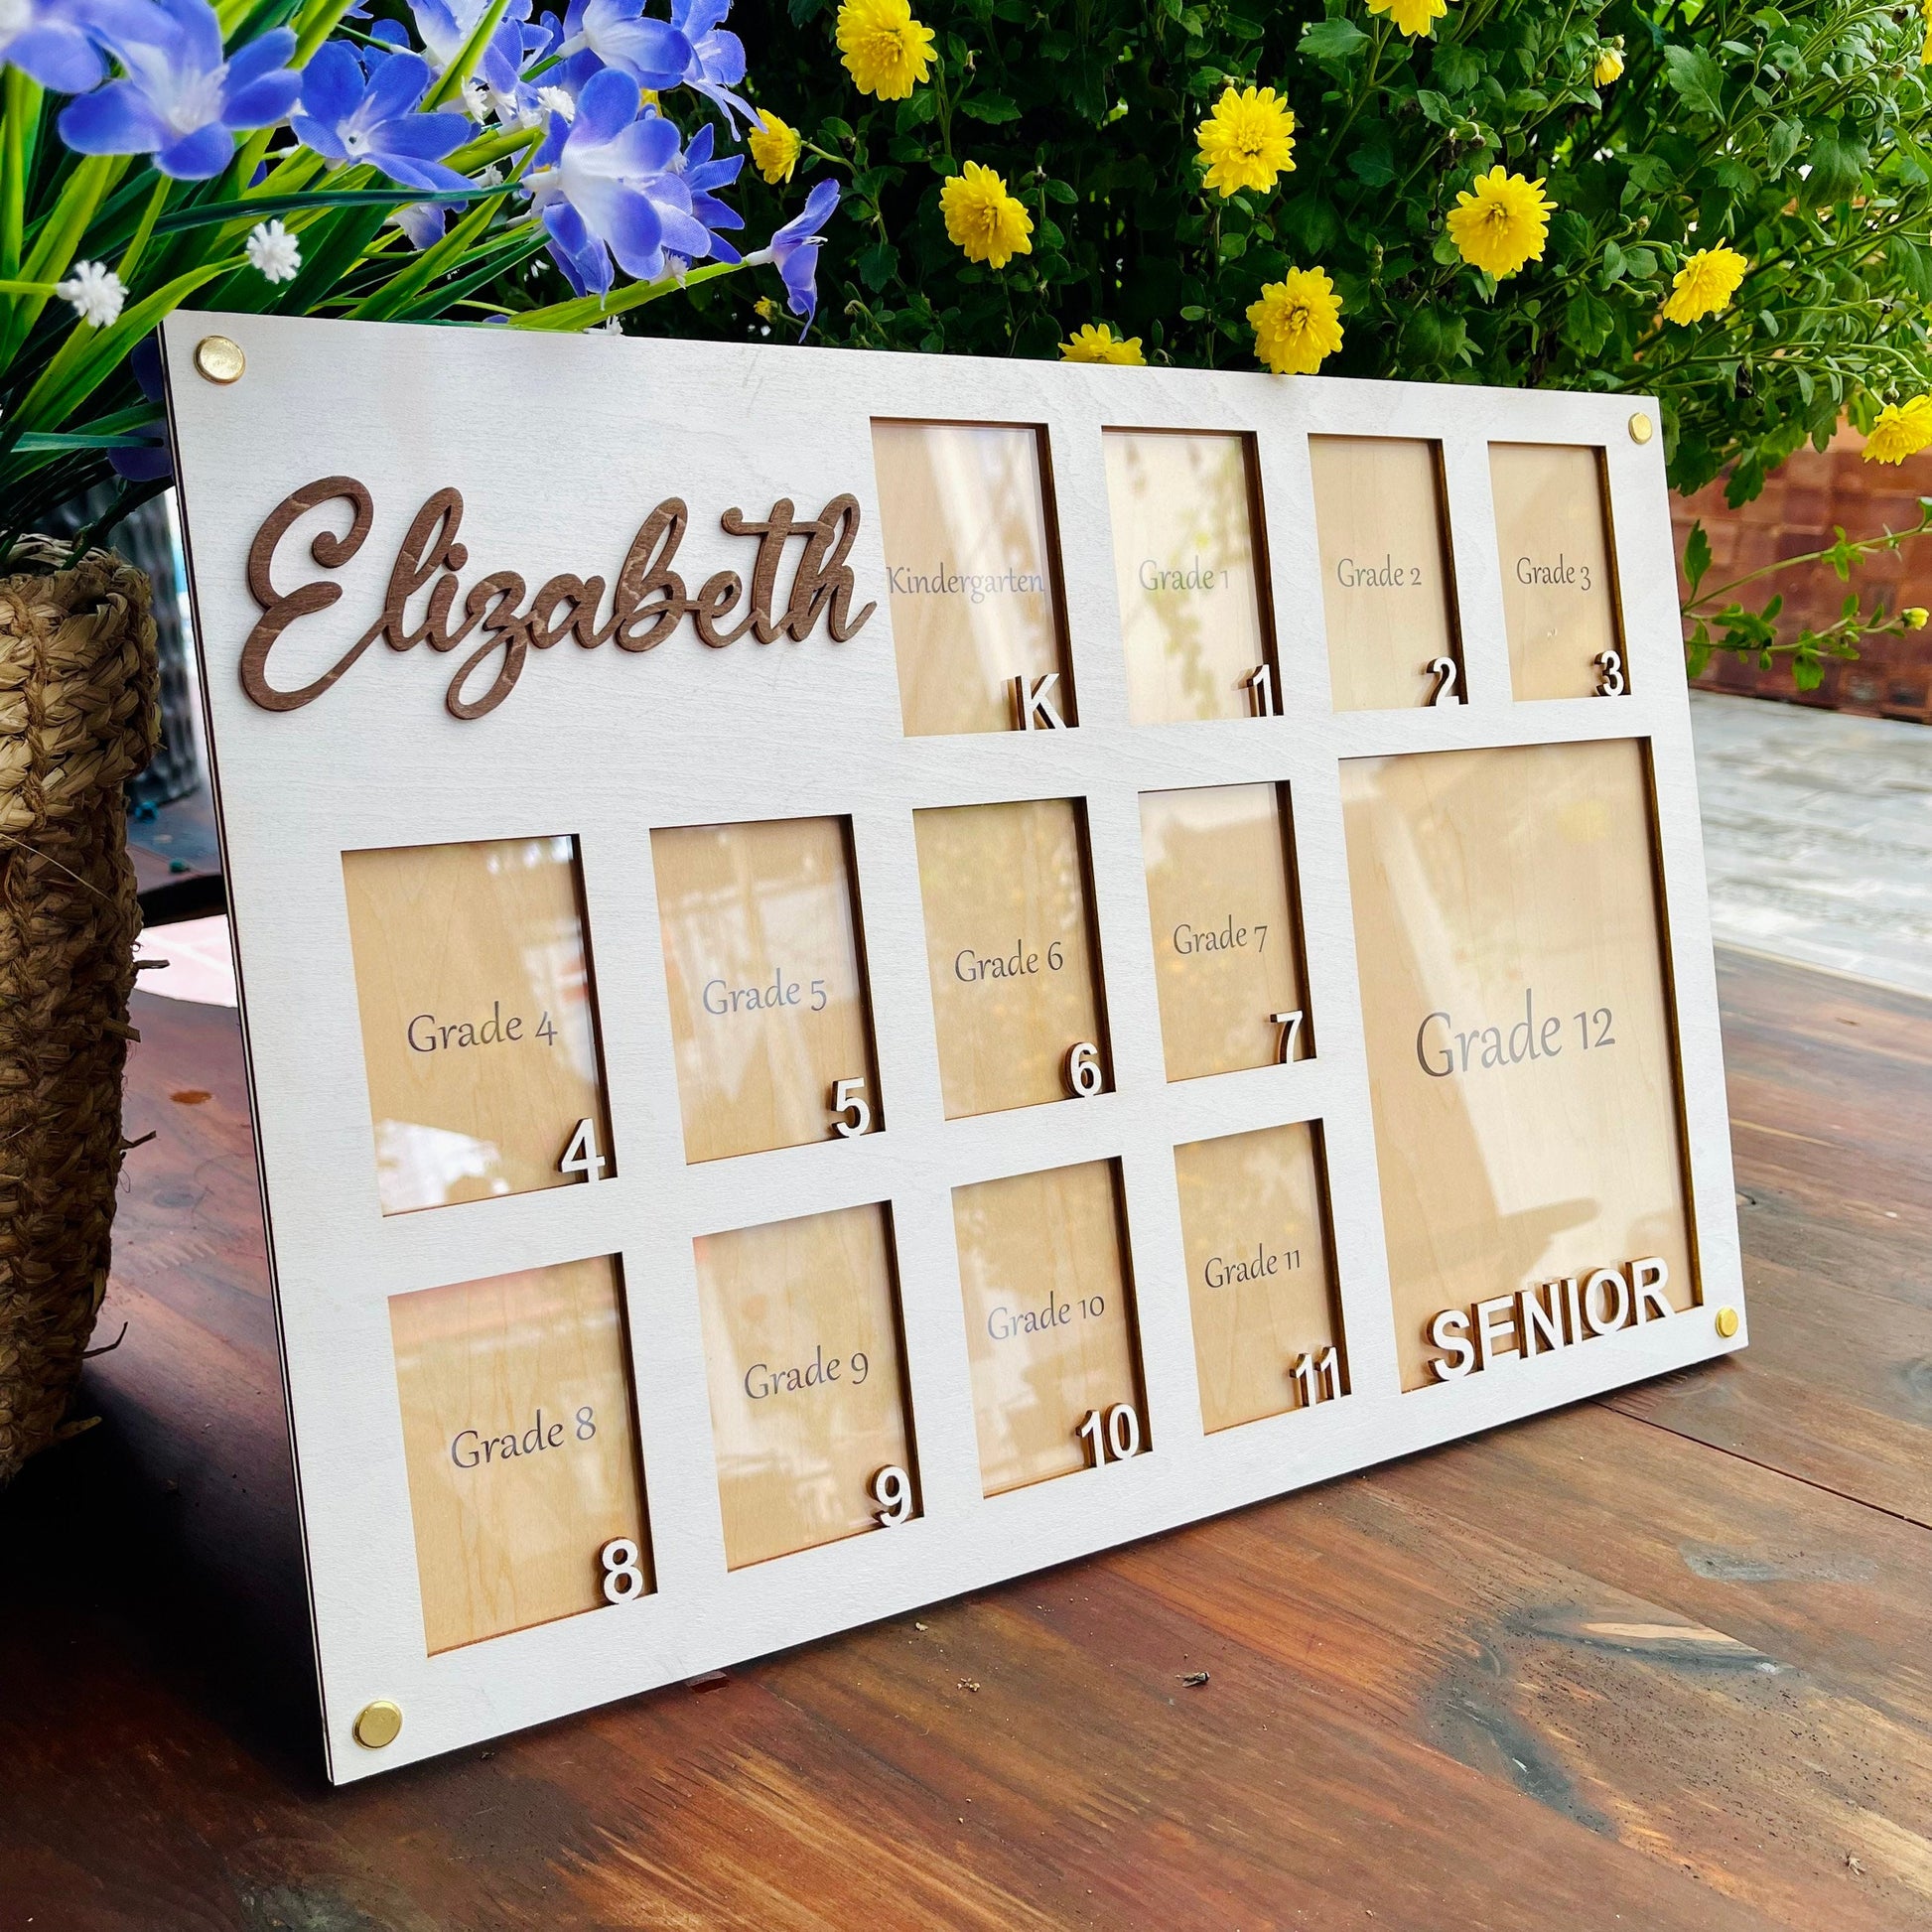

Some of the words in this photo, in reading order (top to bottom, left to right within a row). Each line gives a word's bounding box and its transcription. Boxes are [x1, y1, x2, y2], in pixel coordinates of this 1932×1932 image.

[886, 562, 1044, 604] Kindergarten
[1138, 556, 1214, 591] Grade
[1220, 570, 1229, 589] 1
[1337, 554, 1405, 588] Grade
[1410, 568, 1422, 586] 2
[1516, 554, 1576, 585] Grade
[1581, 567, 1591, 591] 3
[240, 476, 877, 720] Elizabeth
[1252, 664, 1272, 717] 1
[1433, 657, 1459, 707] 2
[1599, 650, 1624, 696] 3
[1022, 672, 1066, 731] K
[955, 939, 1038, 982] Grade
[1047, 941, 1063, 971] 6
[1173, 914, 1247, 955] Grade
[1254, 925, 1268, 953] 7
[702, 968, 801, 1016] Grade
[810, 979, 827, 1012] 5
[407, 1002, 523, 1052] Grade
[535, 1012, 558, 1045] 4
[1274, 1011, 1303, 1063] 7
[1416, 988, 1563, 1077] Grade
[1574, 1007, 1616, 1050] 12
[1070, 1042, 1102, 1096] 6
[833, 1077, 870, 1138] 5
[560, 1117, 605, 1182] 4
[1204, 1243, 1278, 1288] Grade
[1284, 1248, 1301, 1272] 11
[987, 1291, 1071, 1340] Grade
[1077, 1295, 1105, 1320] 10
[1430, 1256, 1676, 1381] SENIOR
[744, 1345, 841, 1399] Grade
[850, 1352, 869, 1385] 9
[1293, 1346, 1341, 1407] 11
[451, 1409, 565, 1468] Grade
[575, 1406, 596, 1442] 8
[1078, 1404, 1140, 1468] 10
[875, 1464, 911, 1527] 9
[601, 1538, 643, 1604] 8
